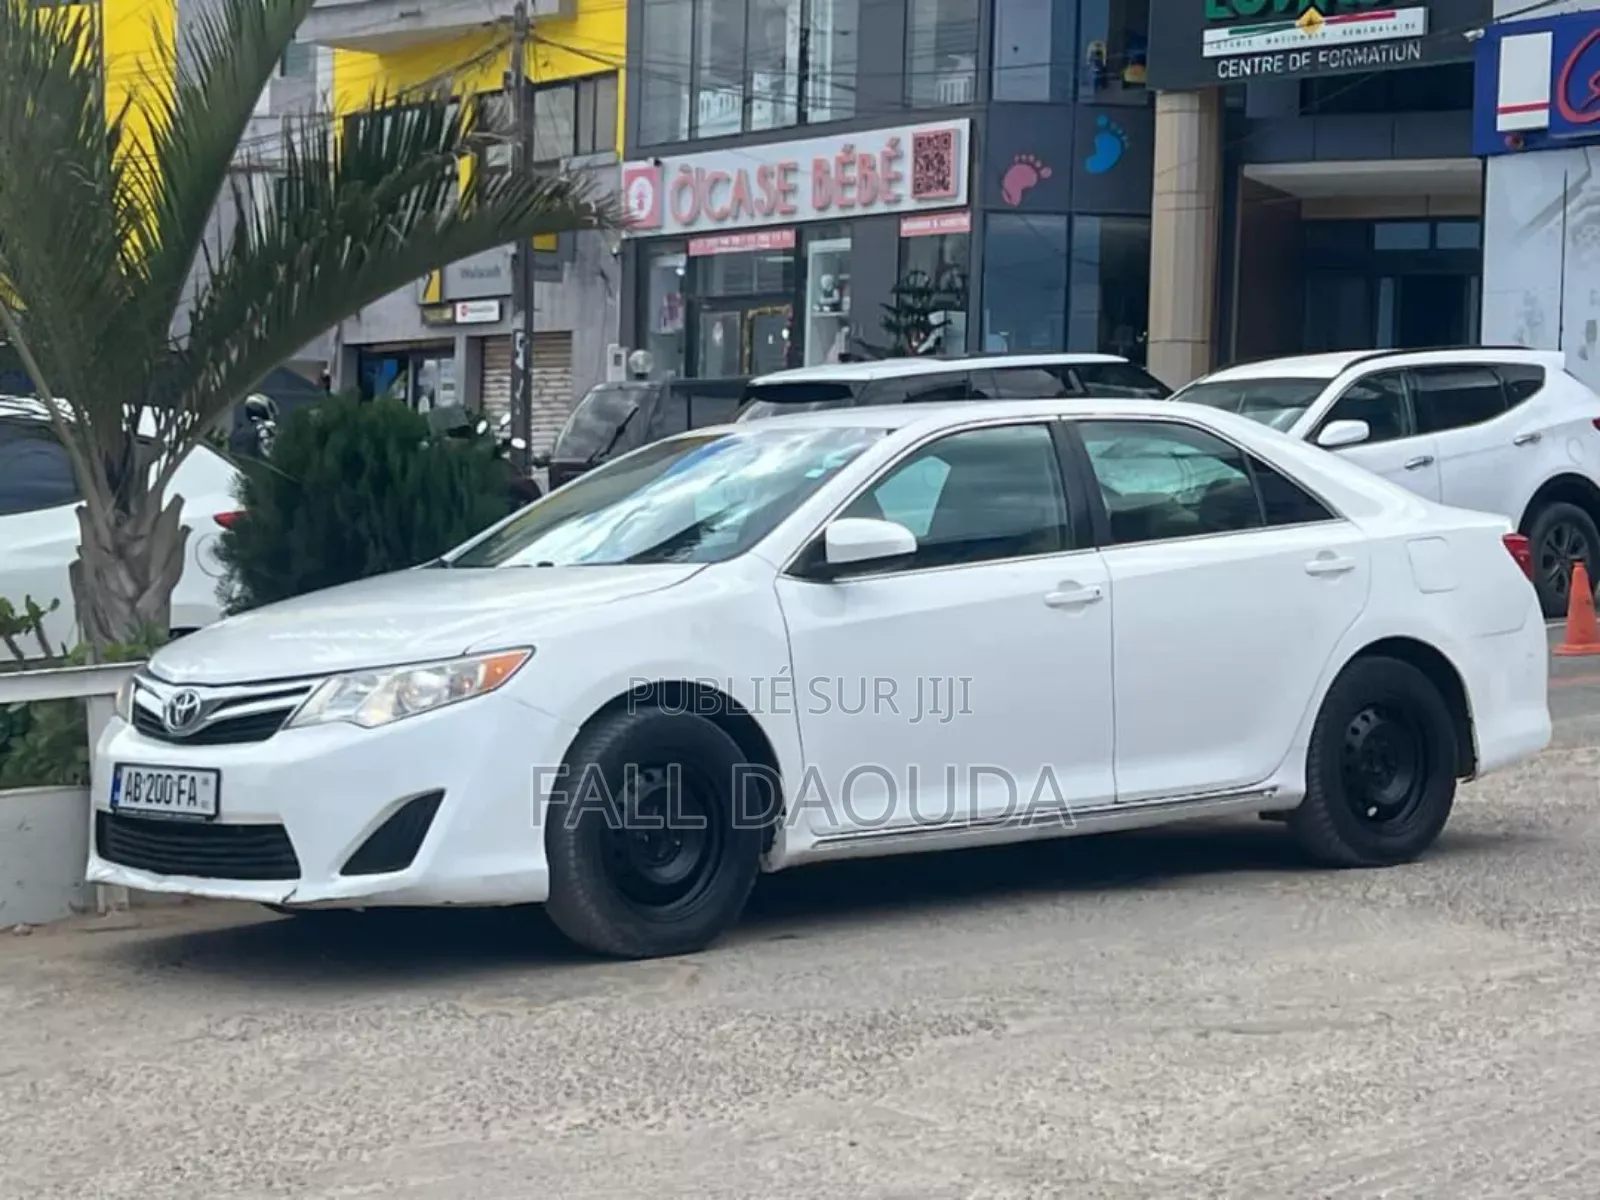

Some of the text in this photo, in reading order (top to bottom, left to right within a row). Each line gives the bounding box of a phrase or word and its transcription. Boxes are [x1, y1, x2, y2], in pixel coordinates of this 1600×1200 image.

[1217, 40, 1422, 79] CENTRE DE FORMATION
[811, 137, 904, 212] BÉBÉ
